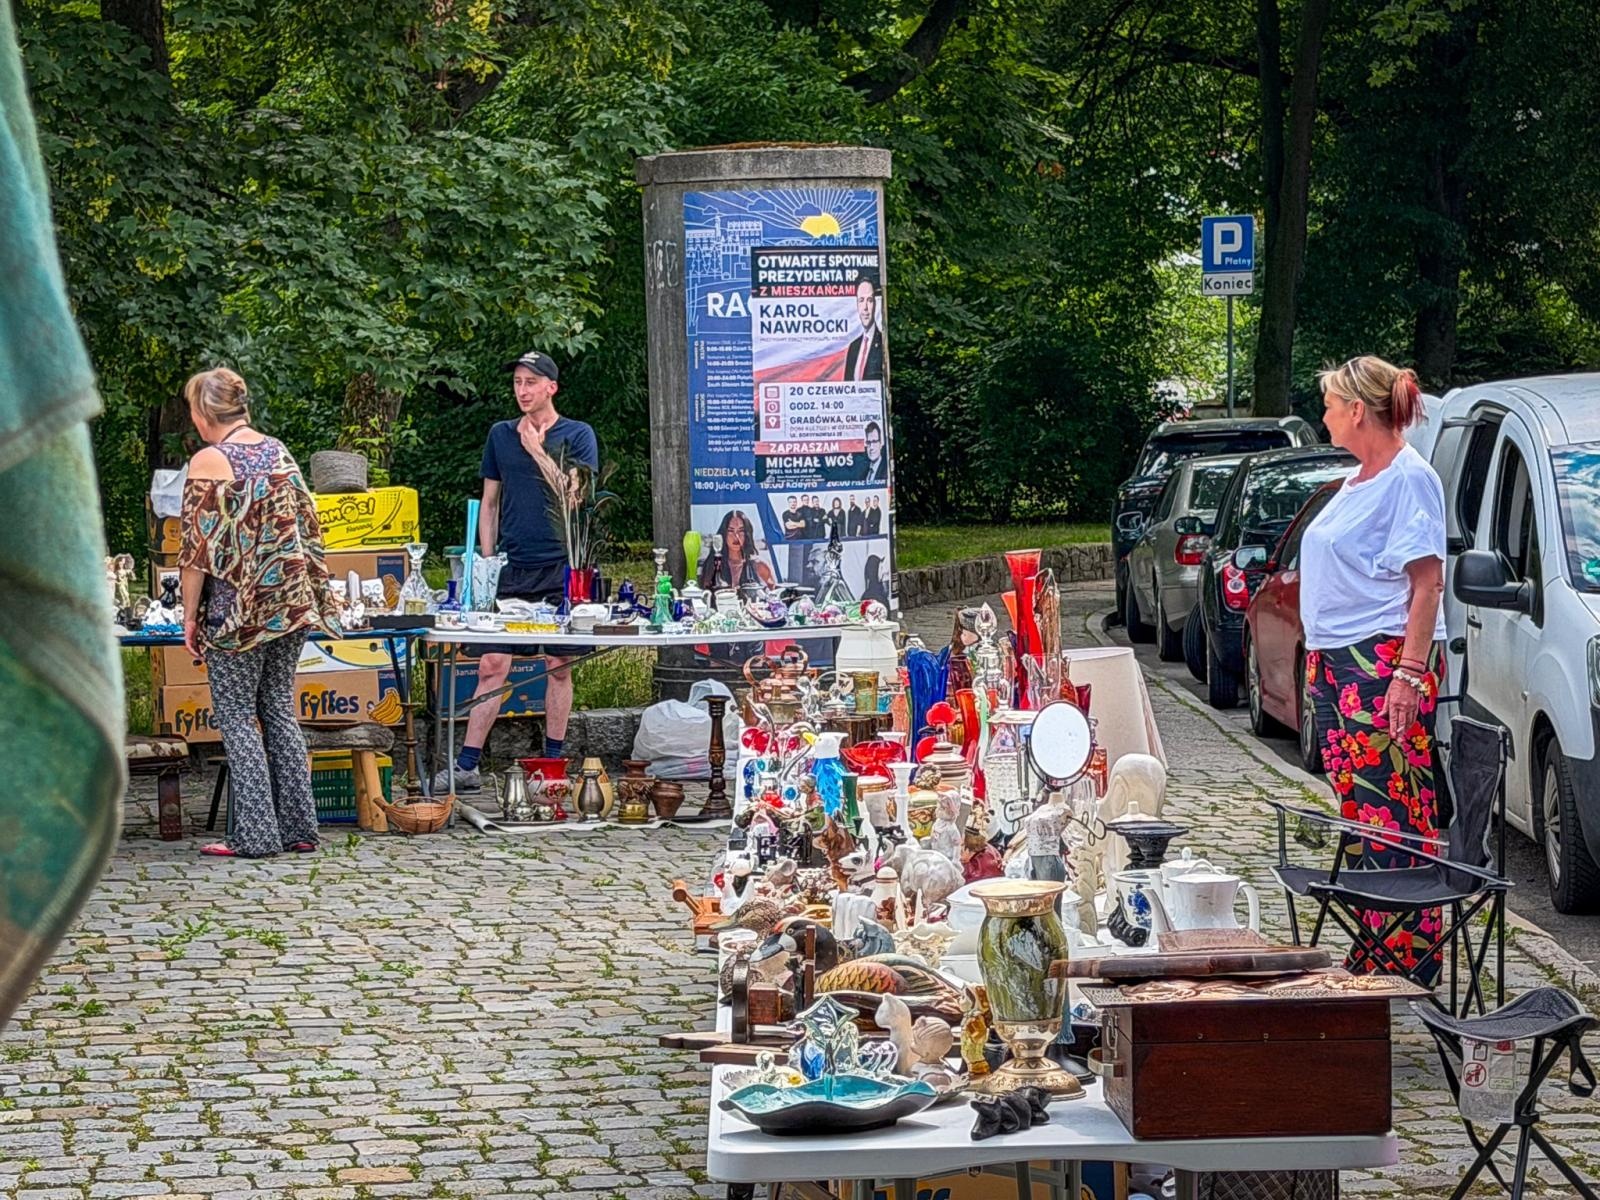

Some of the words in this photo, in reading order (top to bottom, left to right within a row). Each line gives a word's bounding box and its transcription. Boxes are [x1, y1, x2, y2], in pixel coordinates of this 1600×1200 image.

[1213, 222, 1242, 265] P
[758, 255, 826, 268] OTWARTE
[758, 269, 844, 283] PREZYDENTA
[845, 269, 859, 282] RP
[1204, 276, 1251, 290] Koniec
[760, 287, 768, 296] Z
[771, 284, 856, 296] MIESZKAŃCAMI
[760, 304, 819, 318] KAROL
[760, 319, 848, 334] NAWROCKI
[790, 387, 803, 396] 20
[807, 385, 856, 395] CZERWCA
[789, 402, 819, 410] GODZ.
[821, 401, 844, 409] 14:00
[789, 414, 843, 424] GRABÓWKA,
[769, 442, 839, 453] ZAPRASZAM
[766, 456, 821, 468] MICHAŁ
[825, 453, 854, 467] WOŚ
[694, 467, 738, 477] NIEDZIELA
[300, 690, 360, 720] fyffes
[175, 708, 222, 736] fyffe
